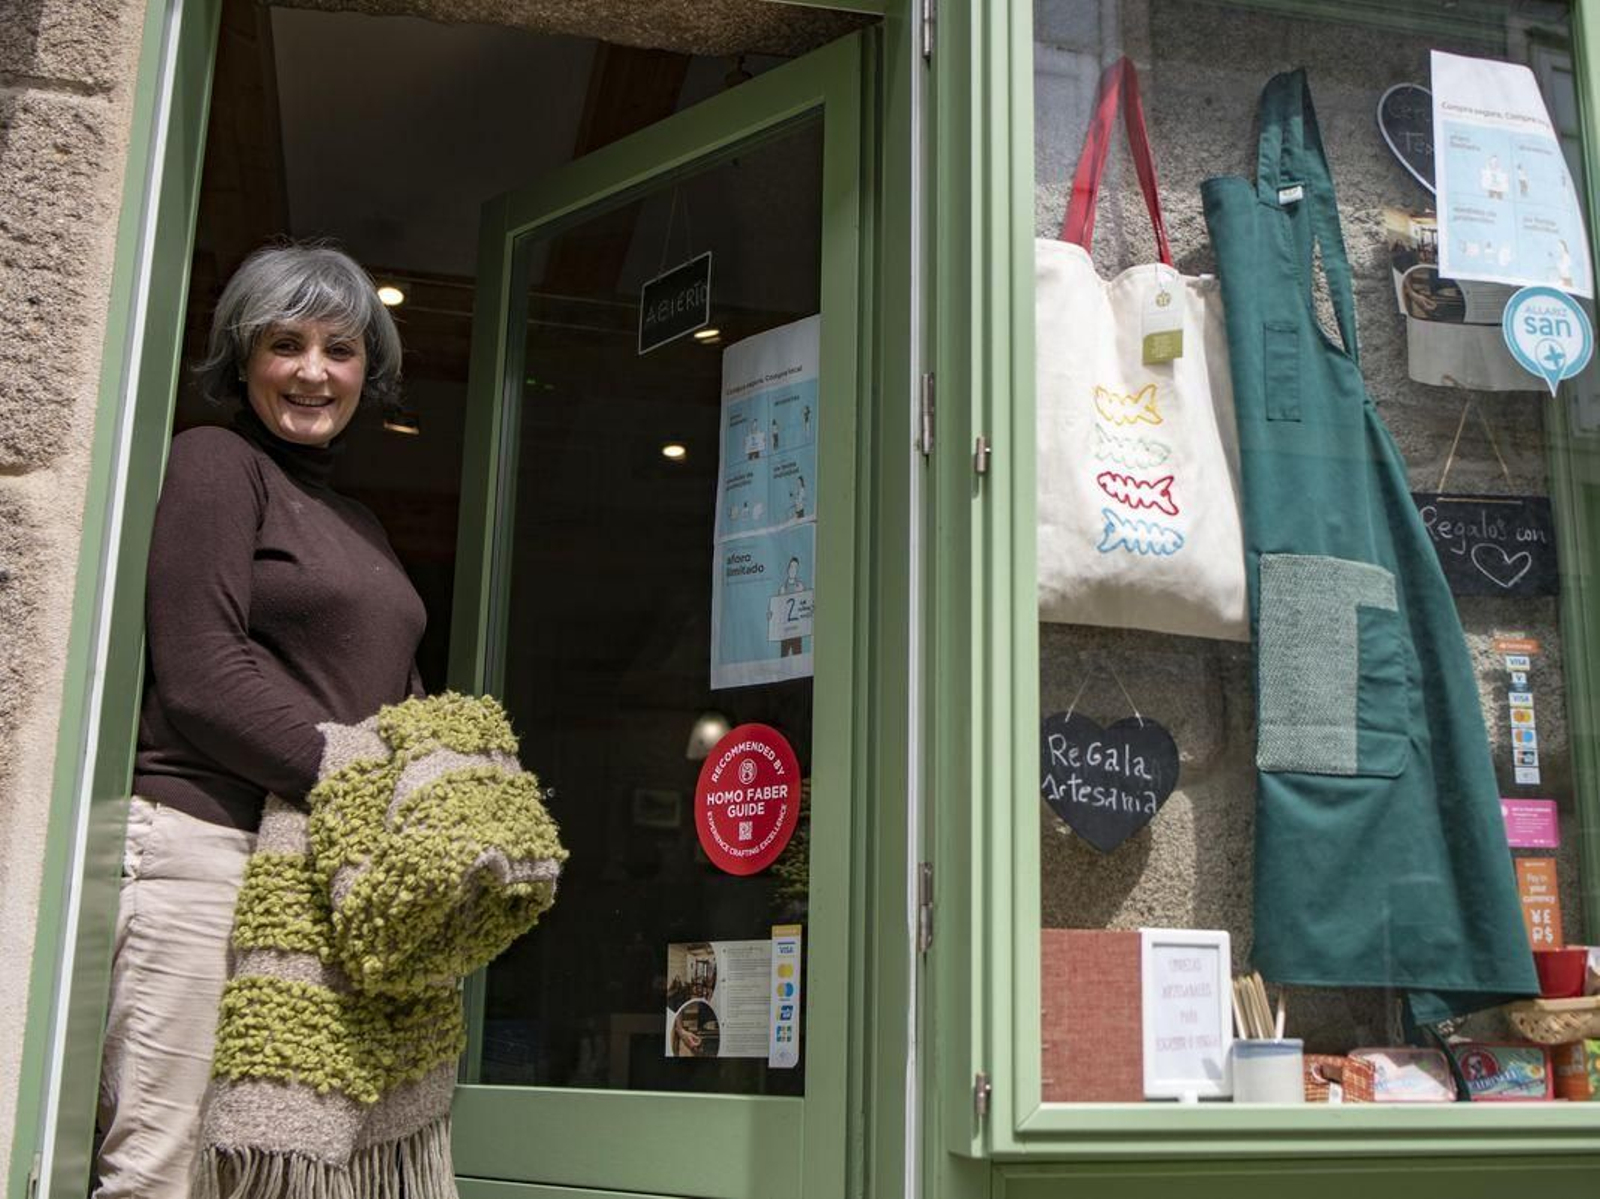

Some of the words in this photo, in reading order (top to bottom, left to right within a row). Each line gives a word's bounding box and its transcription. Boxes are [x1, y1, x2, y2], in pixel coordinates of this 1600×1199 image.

[1524, 314, 1572, 338] san
[1420, 506, 1507, 555] Regalos
[1516, 527, 1547, 544] con
[726, 553, 751, 566] aforo
[726, 563, 765, 577] limitado
[787, 598, 799, 622] 2
[711, 741, 776, 783] RECOMMENDED
[773, 759, 785, 776] BY
[706, 790, 743, 806] HOMO
[746, 785, 788, 801] FABER
[727, 802, 765, 818] GUIDE
[729, 846, 761, 858] CRAFTING
[760, 804, 788, 850] EXCELLENCE
